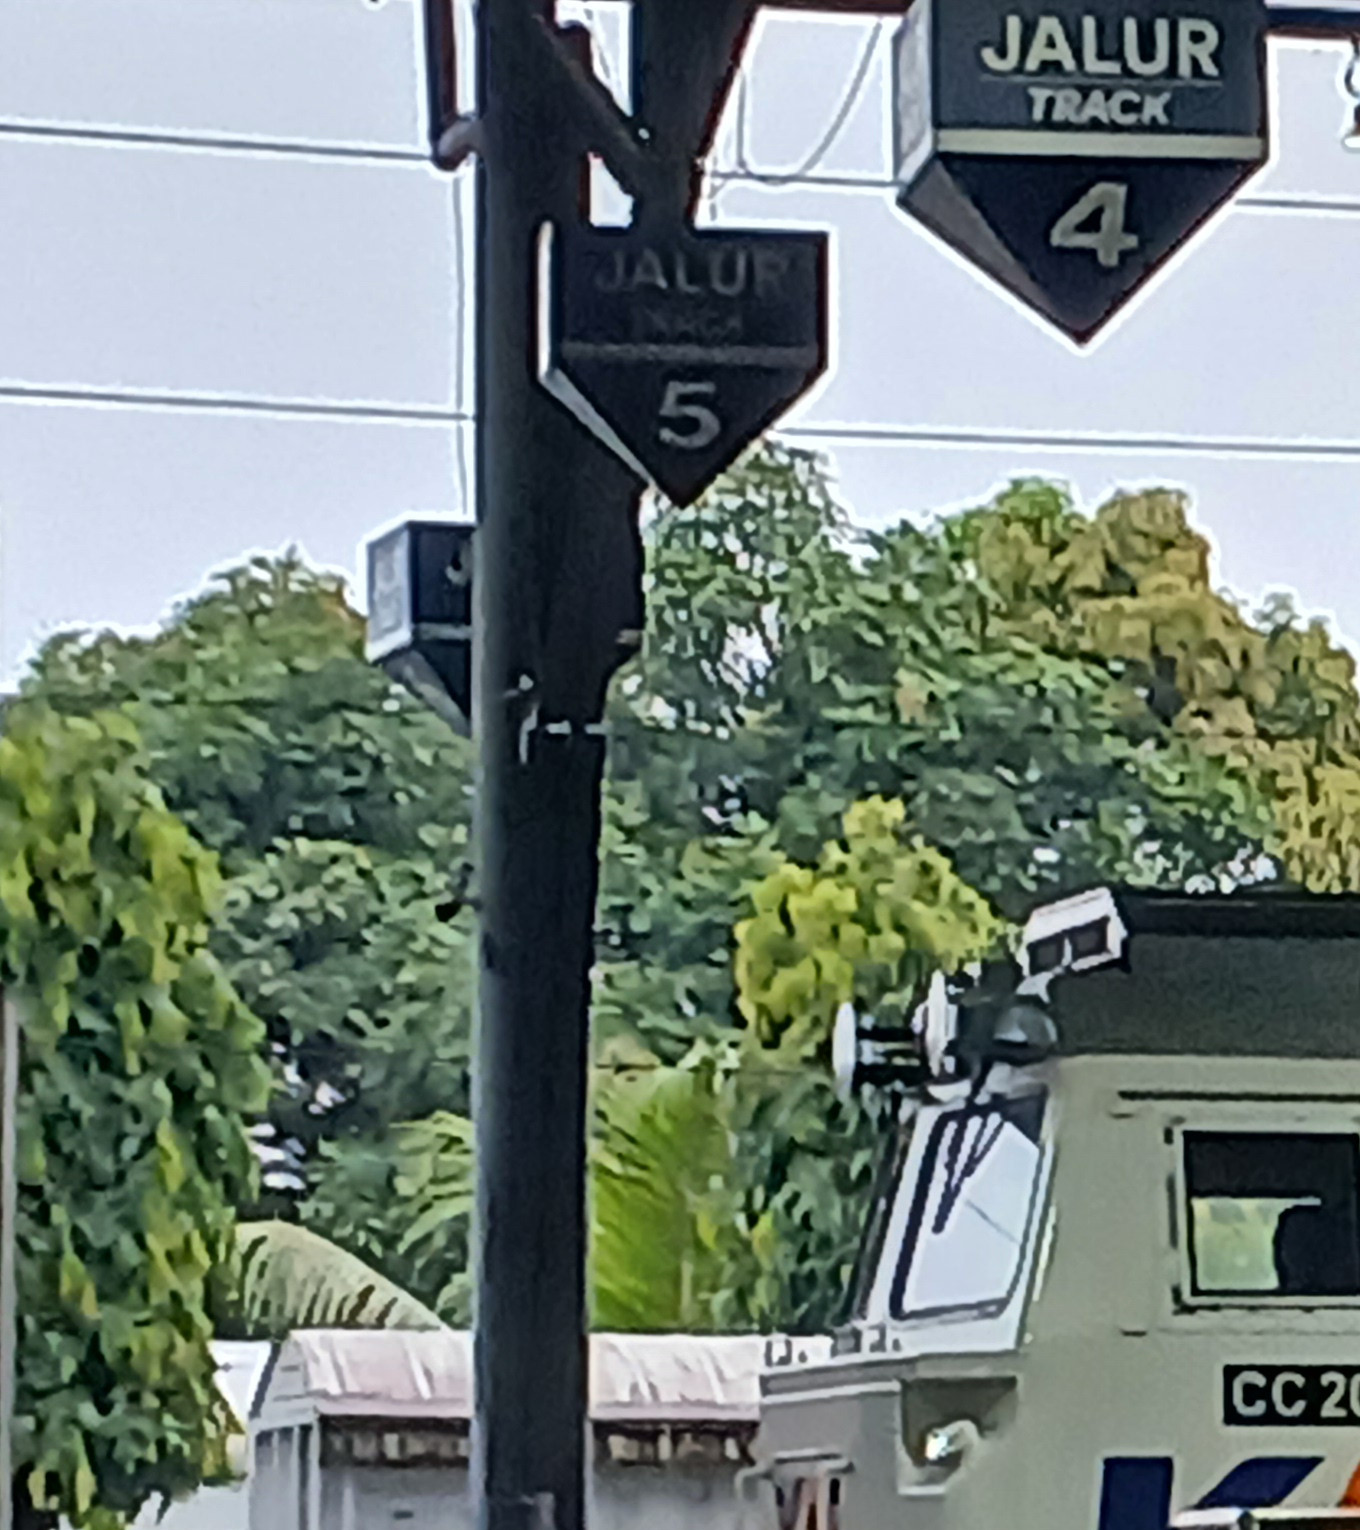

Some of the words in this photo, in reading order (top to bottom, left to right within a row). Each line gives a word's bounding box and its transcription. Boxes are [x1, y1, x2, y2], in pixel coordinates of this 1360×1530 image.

[980, 14, 1220, 77] JALUR
[1028, 87, 1172, 125] TRACK
[1050, 181, 1139, 268] 4
[594, 246, 789, 297] JALUR
[658, 380, 721, 449] 5
[1232, 1371, 1306, 1417] CC
